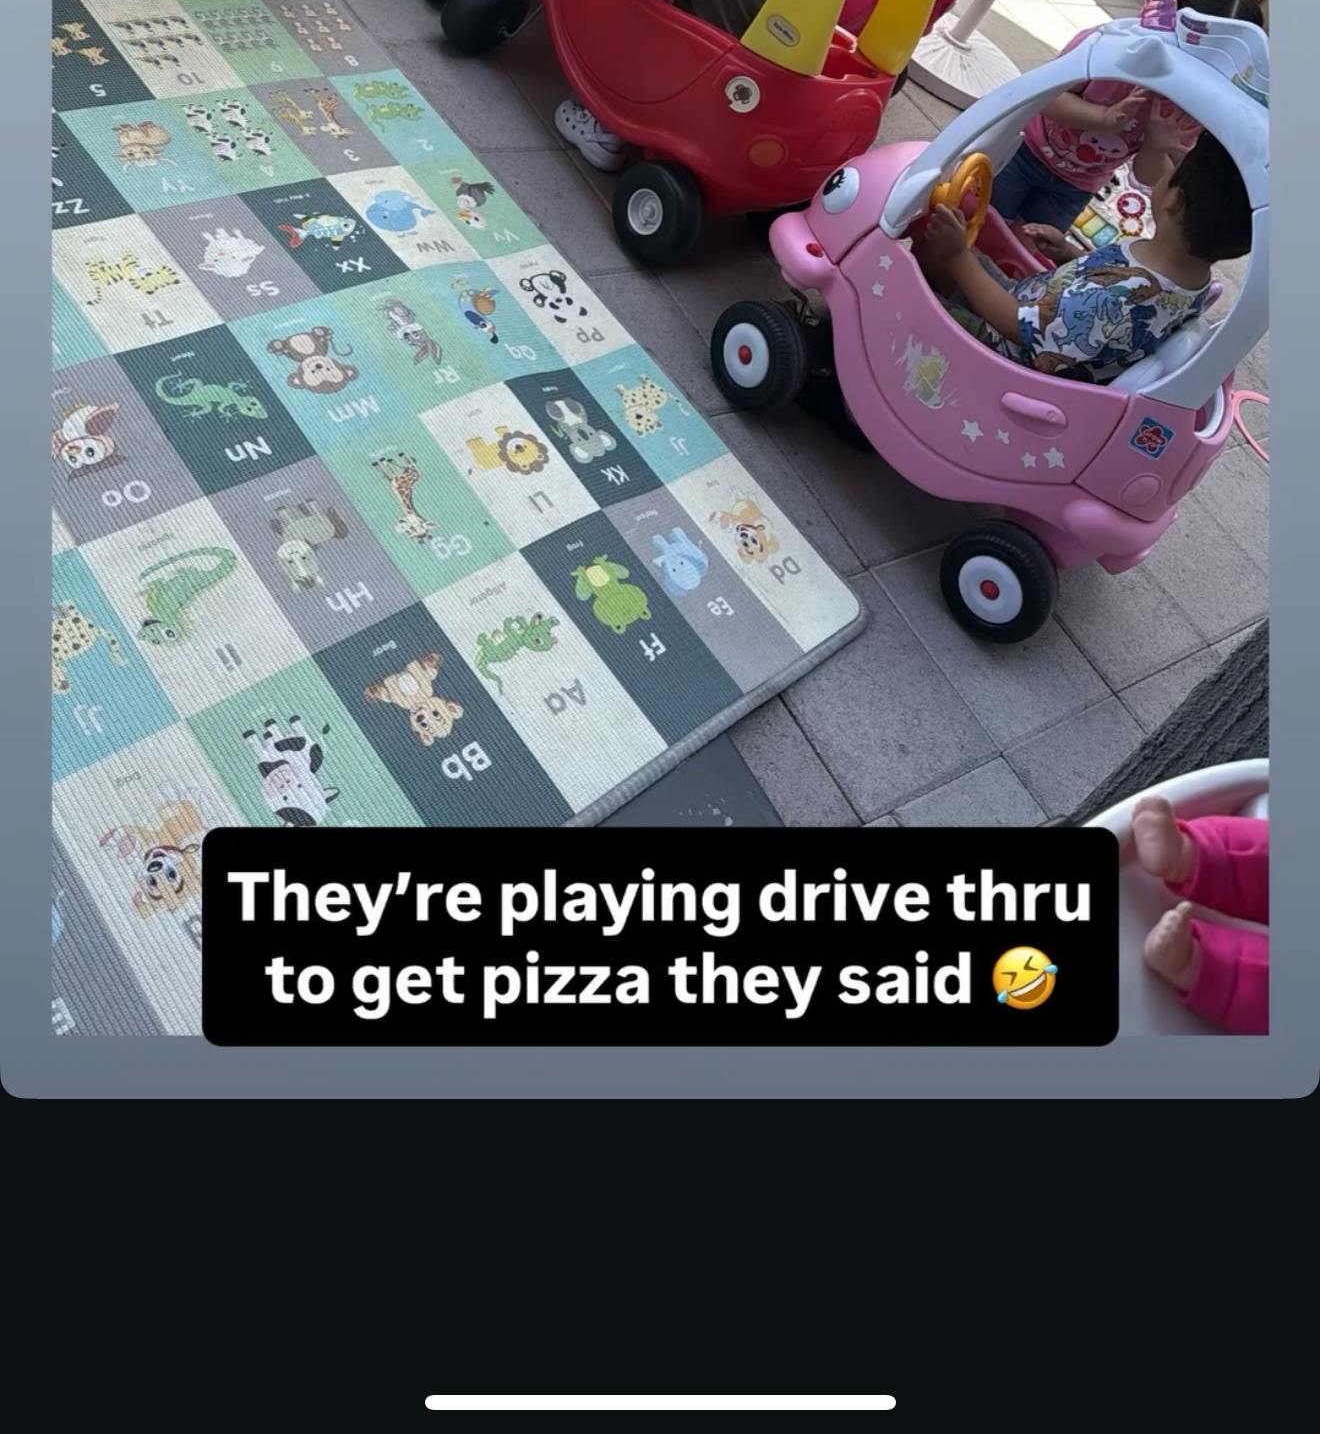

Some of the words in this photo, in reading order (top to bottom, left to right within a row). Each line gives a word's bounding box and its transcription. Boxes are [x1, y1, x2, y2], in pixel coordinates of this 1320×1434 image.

[343, 54, 360, 67] 8
[176, 71, 205, 86] 10
[89, 83, 107, 97] 5
[343, 148, 361, 162] 3
[493, 228, 520, 243] Vv
[415, 239, 456, 254] Ww
[335, 256, 372, 274] Xx
[245, 280, 280, 297] Ss
[140, 309, 175, 330] Tt
[576, 326, 605, 344] Pp
[504, 342, 537, 362] Qq
[432, 365, 462, 385] Rr
[327, 394, 381, 423] Mm
[224, 435, 273, 463] Nn
[600, 464, 631, 486] Kk
[101, 479, 152, 508] Oo
[430, 533, 473, 560] Gg
[768, 555, 802, 585] Dd
[325, 580, 375, 615] Hh
[706, 595, 735, 617] Ee
[638, 631, 667, 663] Ff
[543, 677, 587, 716] Aa
[441, 740, 493, 782] Bb
